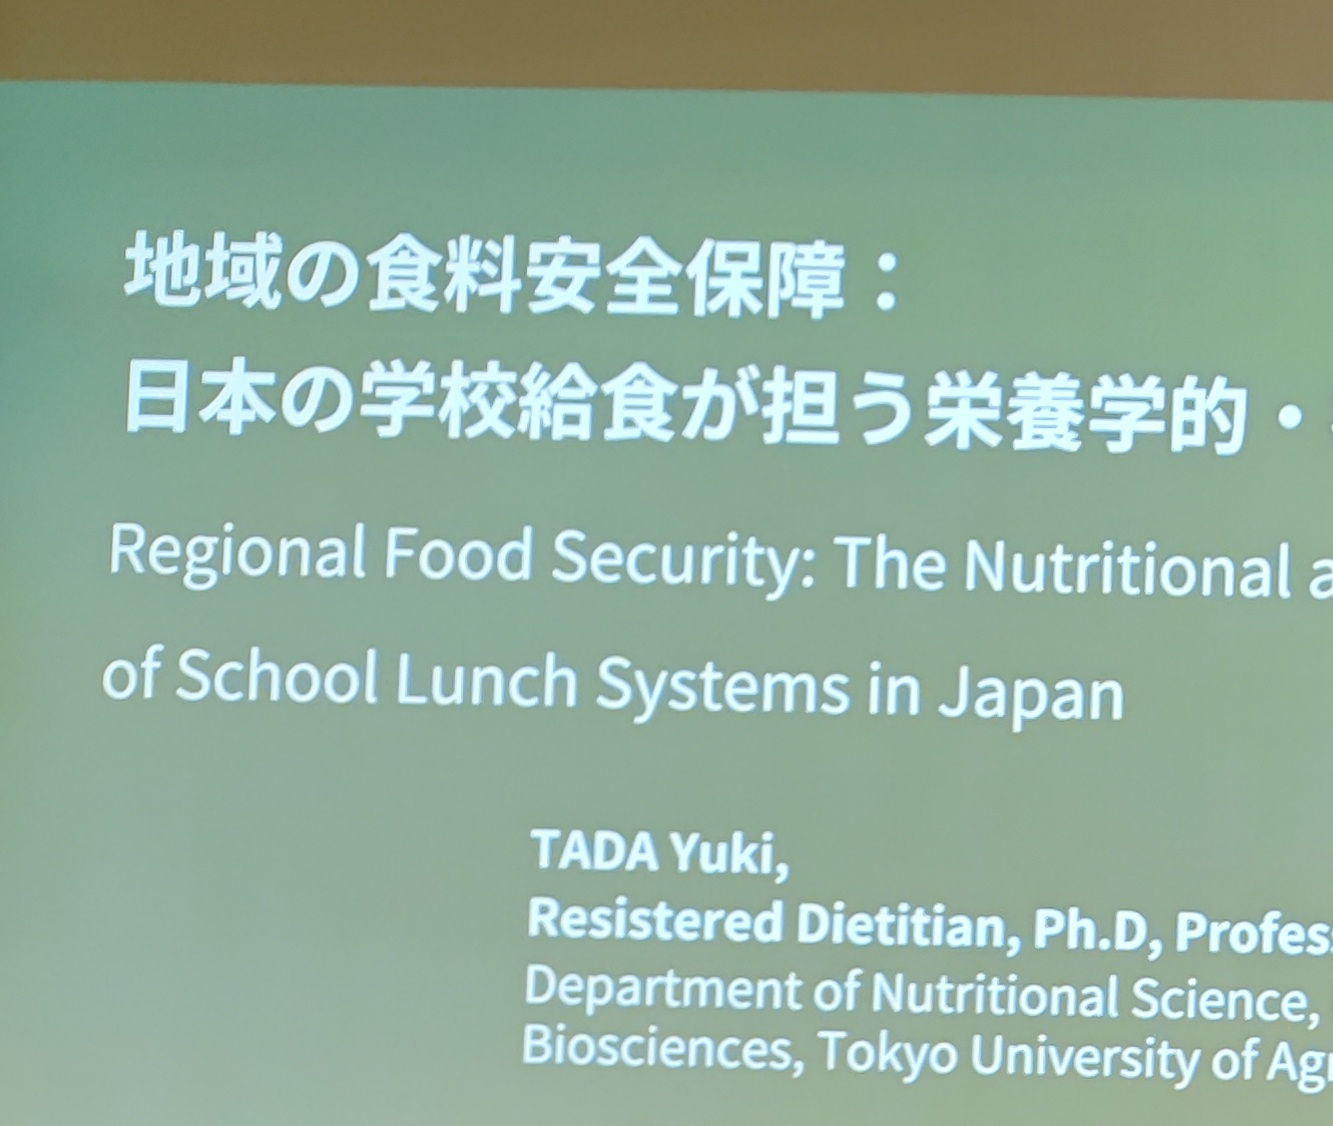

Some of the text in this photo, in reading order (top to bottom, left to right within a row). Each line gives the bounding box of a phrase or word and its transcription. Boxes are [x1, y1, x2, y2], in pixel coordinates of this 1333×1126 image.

[123, 229, 896, 320] 地域の食料安全保障：
[110, 521, 366, 591] Regional
[385, 525, 532, 581] Food
[551, 529, 815, 602] Security:
[833, 533, 946, 591] The
[965, 539, 1291, 599] Nutritional
[102, 643, 1123, 734] of School Lunch Systems in Japan
[530, 828, 789, 885] TADA Yuki,
[528, 895, 783, 943] Resistered
[797, 900, 1020, 958] Dietitian,
[1034, 906, 1162, 962] Ph.D,
[525, 964, 803, 1016] Department
[813, 967, 864, 1011] of
[872, 972, 1119, 1017] Nutritional
[1131, 977, 1320, 1030] Science,
[523, 1022, 804, 1078] Biosciences,
[816, 1029, 958, 1084] Tokyo
[972, 1034, 1202, 1090] University
[1210, 1037, 1262, 1081] of
